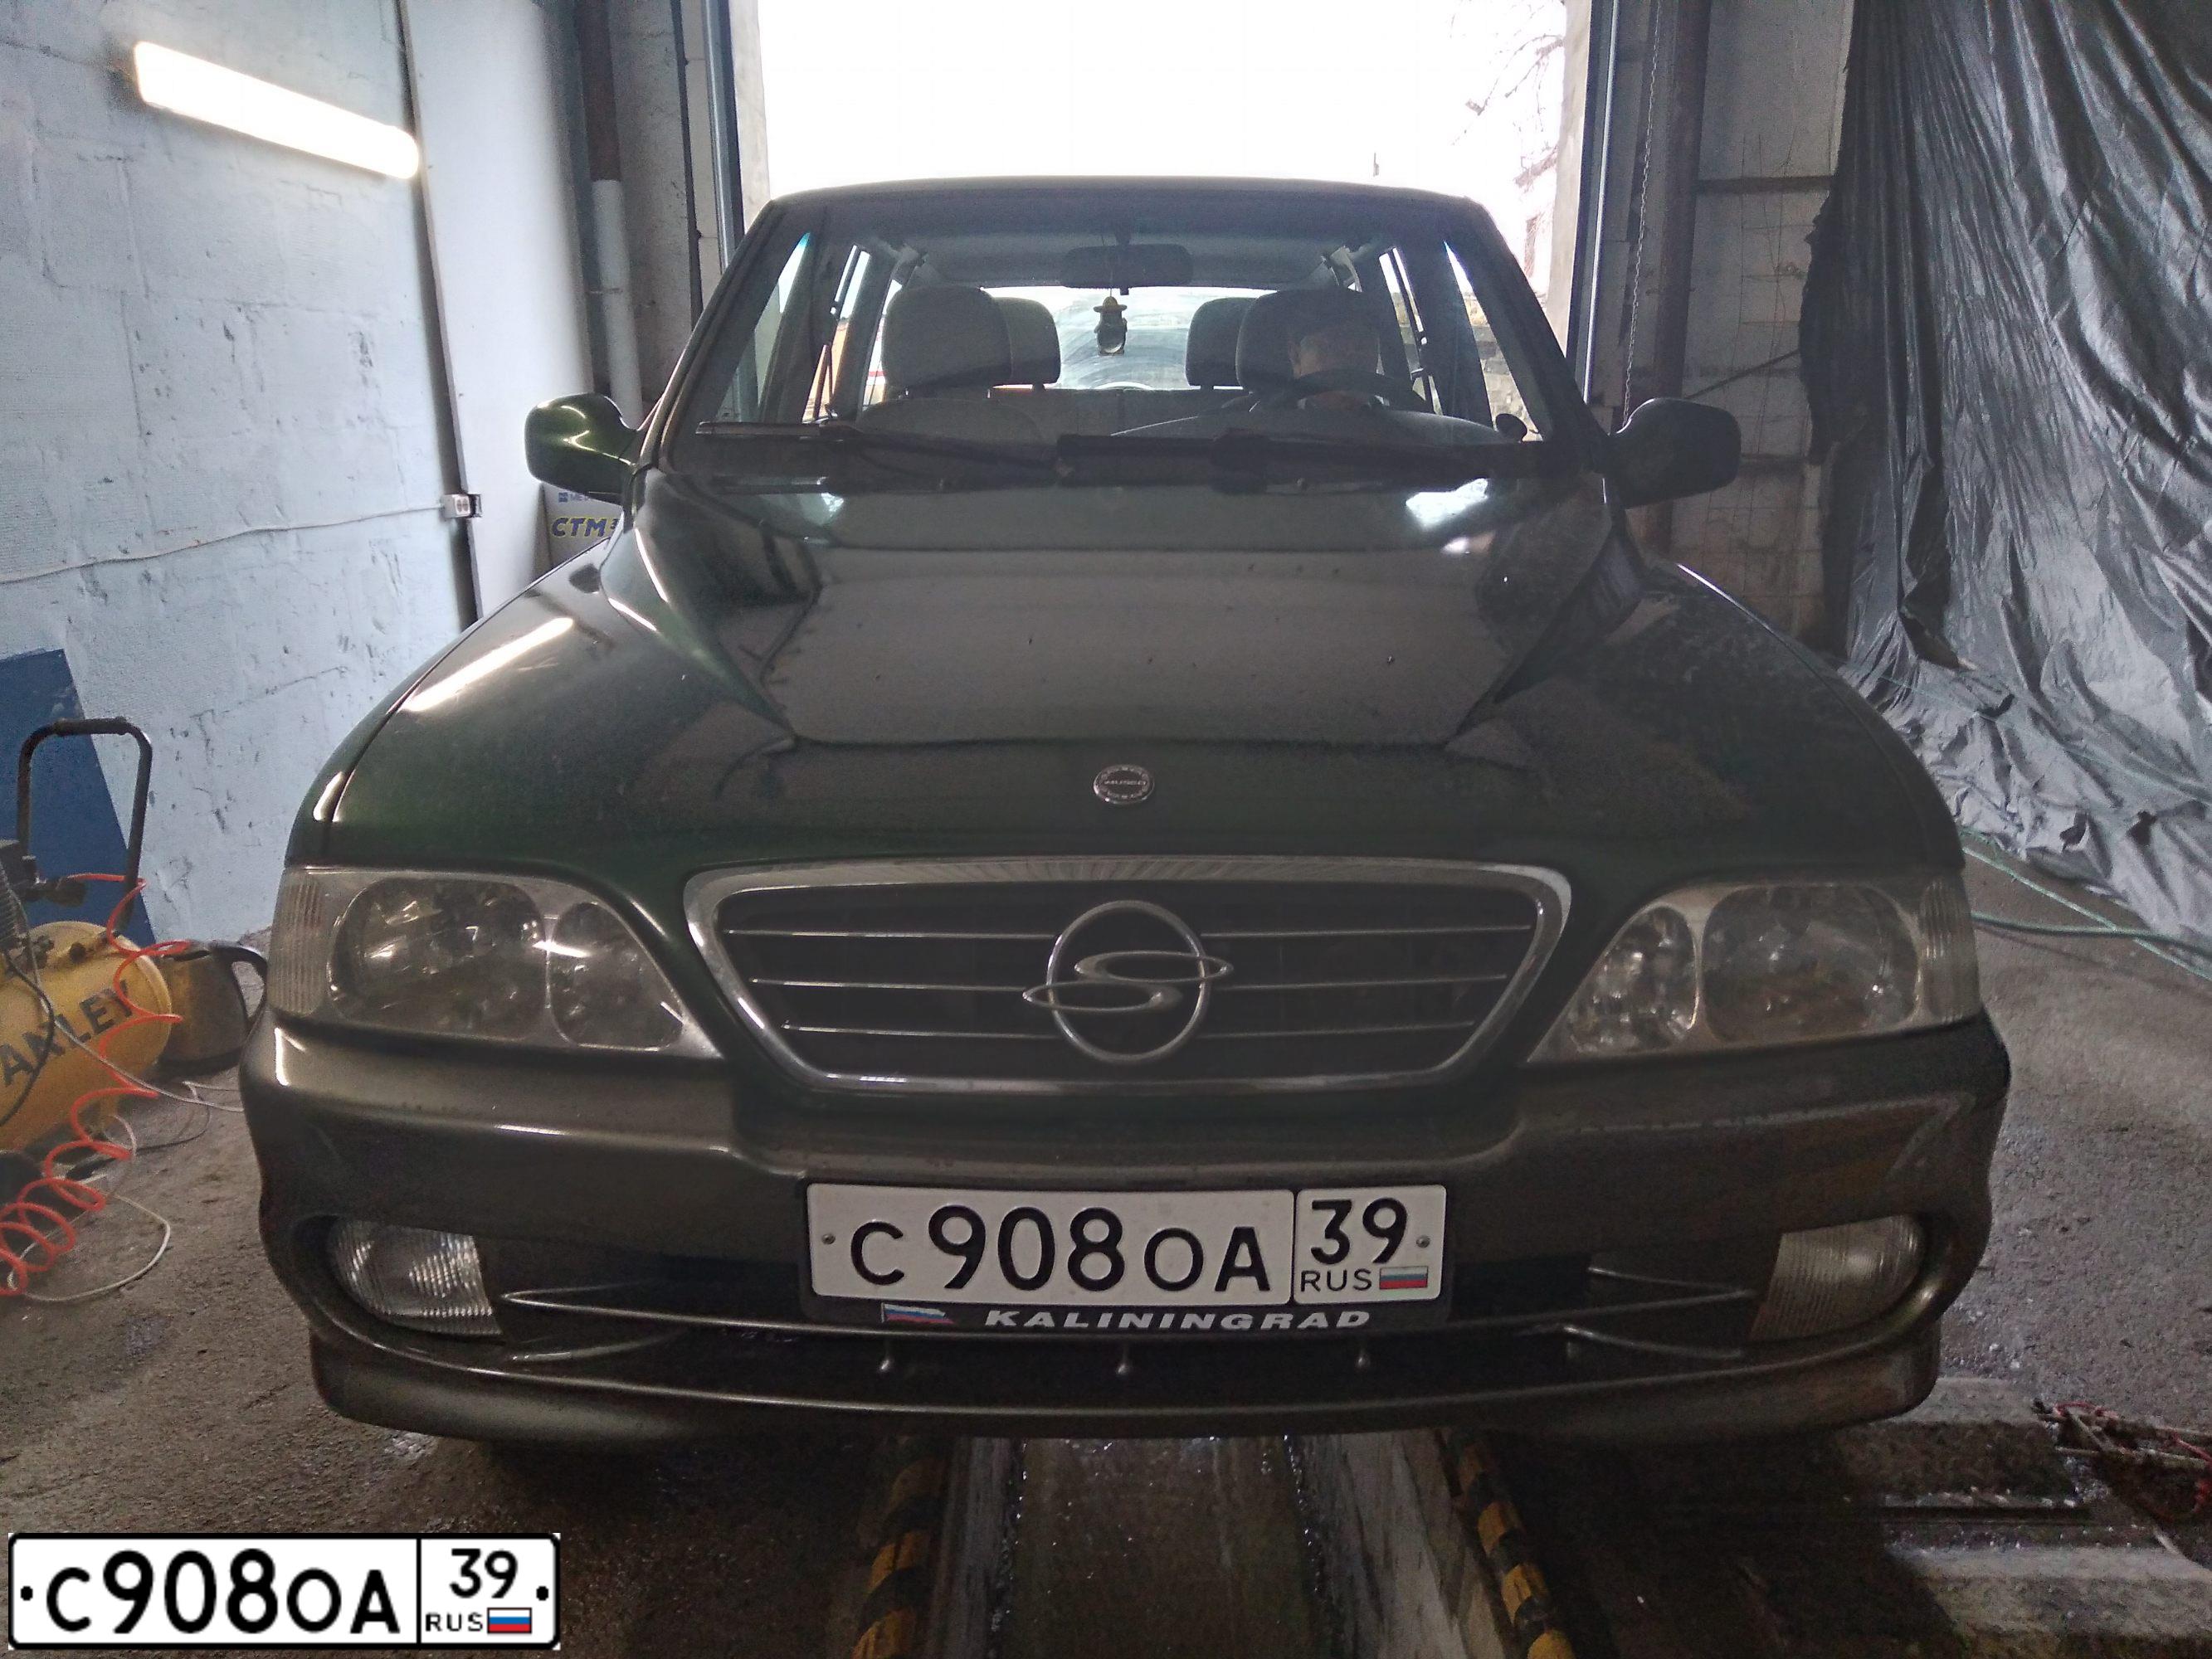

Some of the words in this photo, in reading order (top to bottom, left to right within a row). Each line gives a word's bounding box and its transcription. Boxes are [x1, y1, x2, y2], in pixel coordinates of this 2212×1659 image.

[850, 1205, 1270, 1292] C908OA
[1311, 1199, 1409, 1264] 39
[1301, 1269, 1372, 1292] RUS
[984, 1310, 1371, 1330] KALININGRAD
